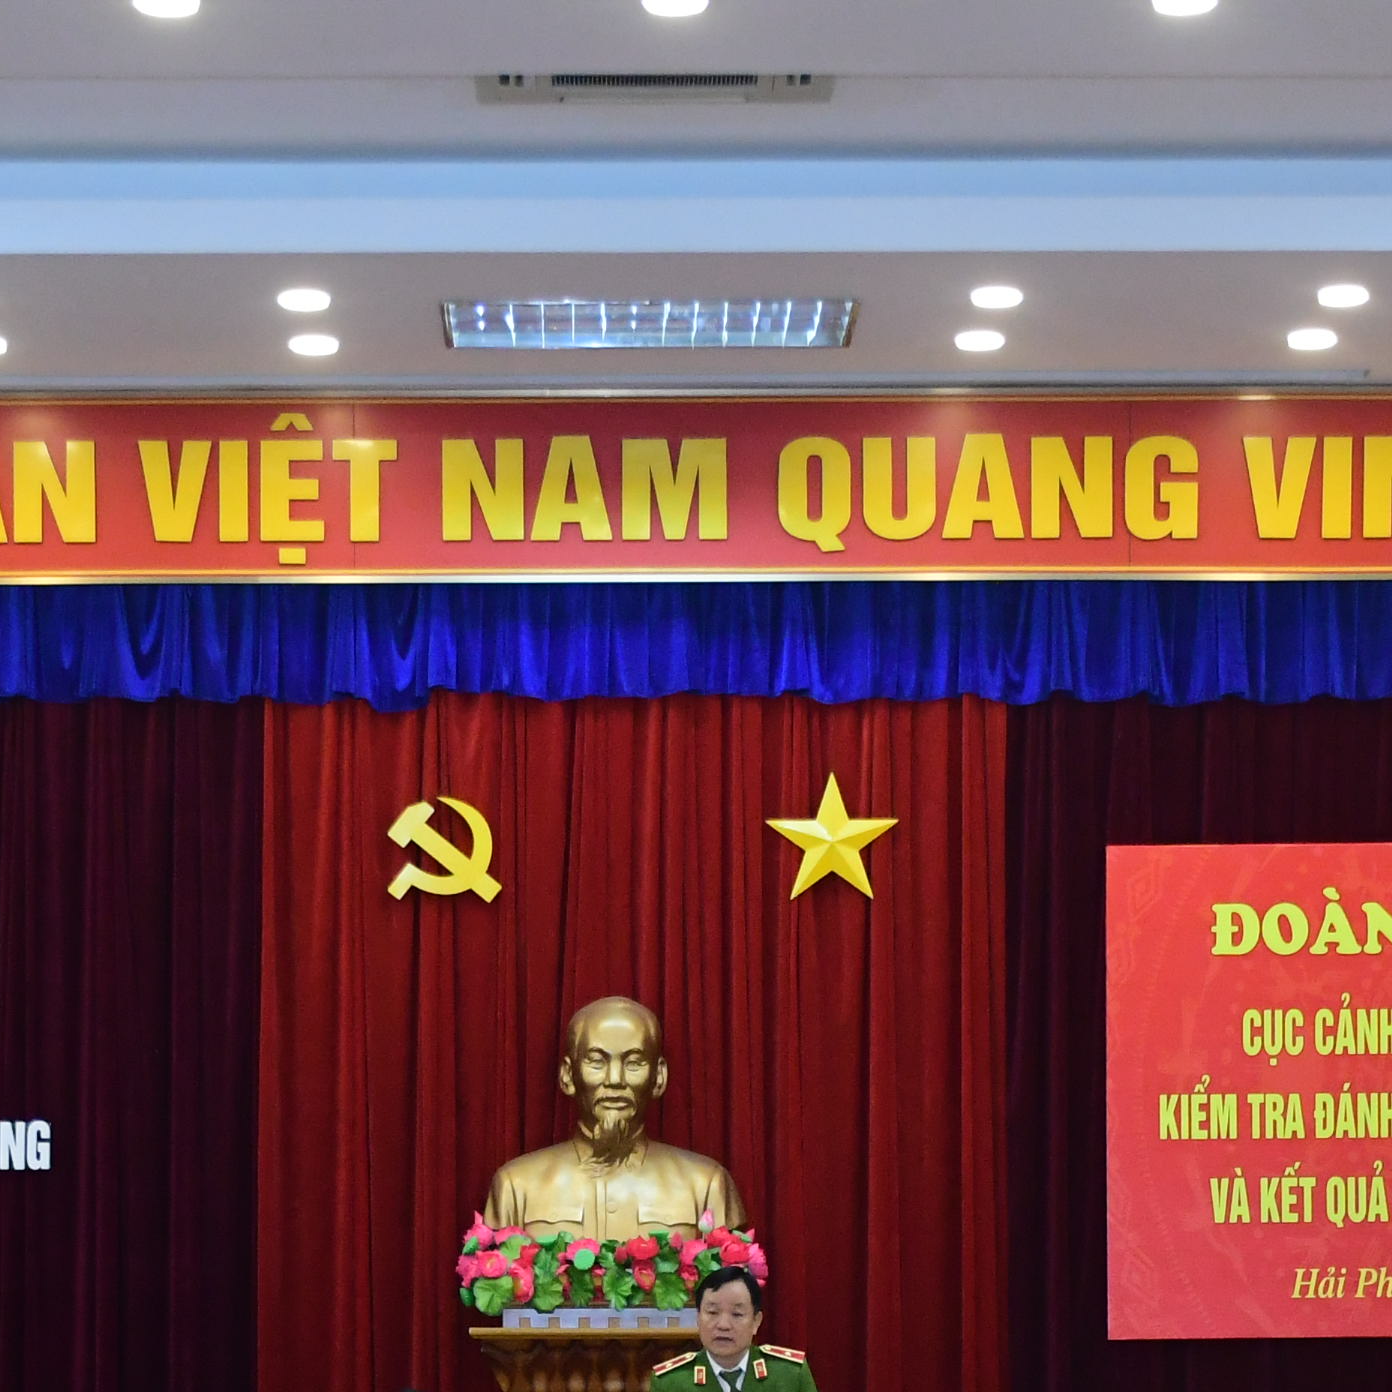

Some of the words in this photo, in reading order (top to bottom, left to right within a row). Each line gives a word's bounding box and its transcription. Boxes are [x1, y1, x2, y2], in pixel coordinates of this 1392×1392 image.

[138, 413, 398, 564] VIỆT
[443, 433, 727, 541] NAM
[777, 432, 1198, 552] QUANG
[1243, 1009, 1304, 1065] CỤC
[1160, 1075, 1237, 1139] KIỂM
[1248, 1093, 1305, 1139] TRA
[1210, 1168, 1250, 1223] VÀ
[1260, 1162, 1316, 1223] KẾT
[1326, 1160, 1388, 1227] QUẢ
[1291, 1267, 1346, 1298] Hải
